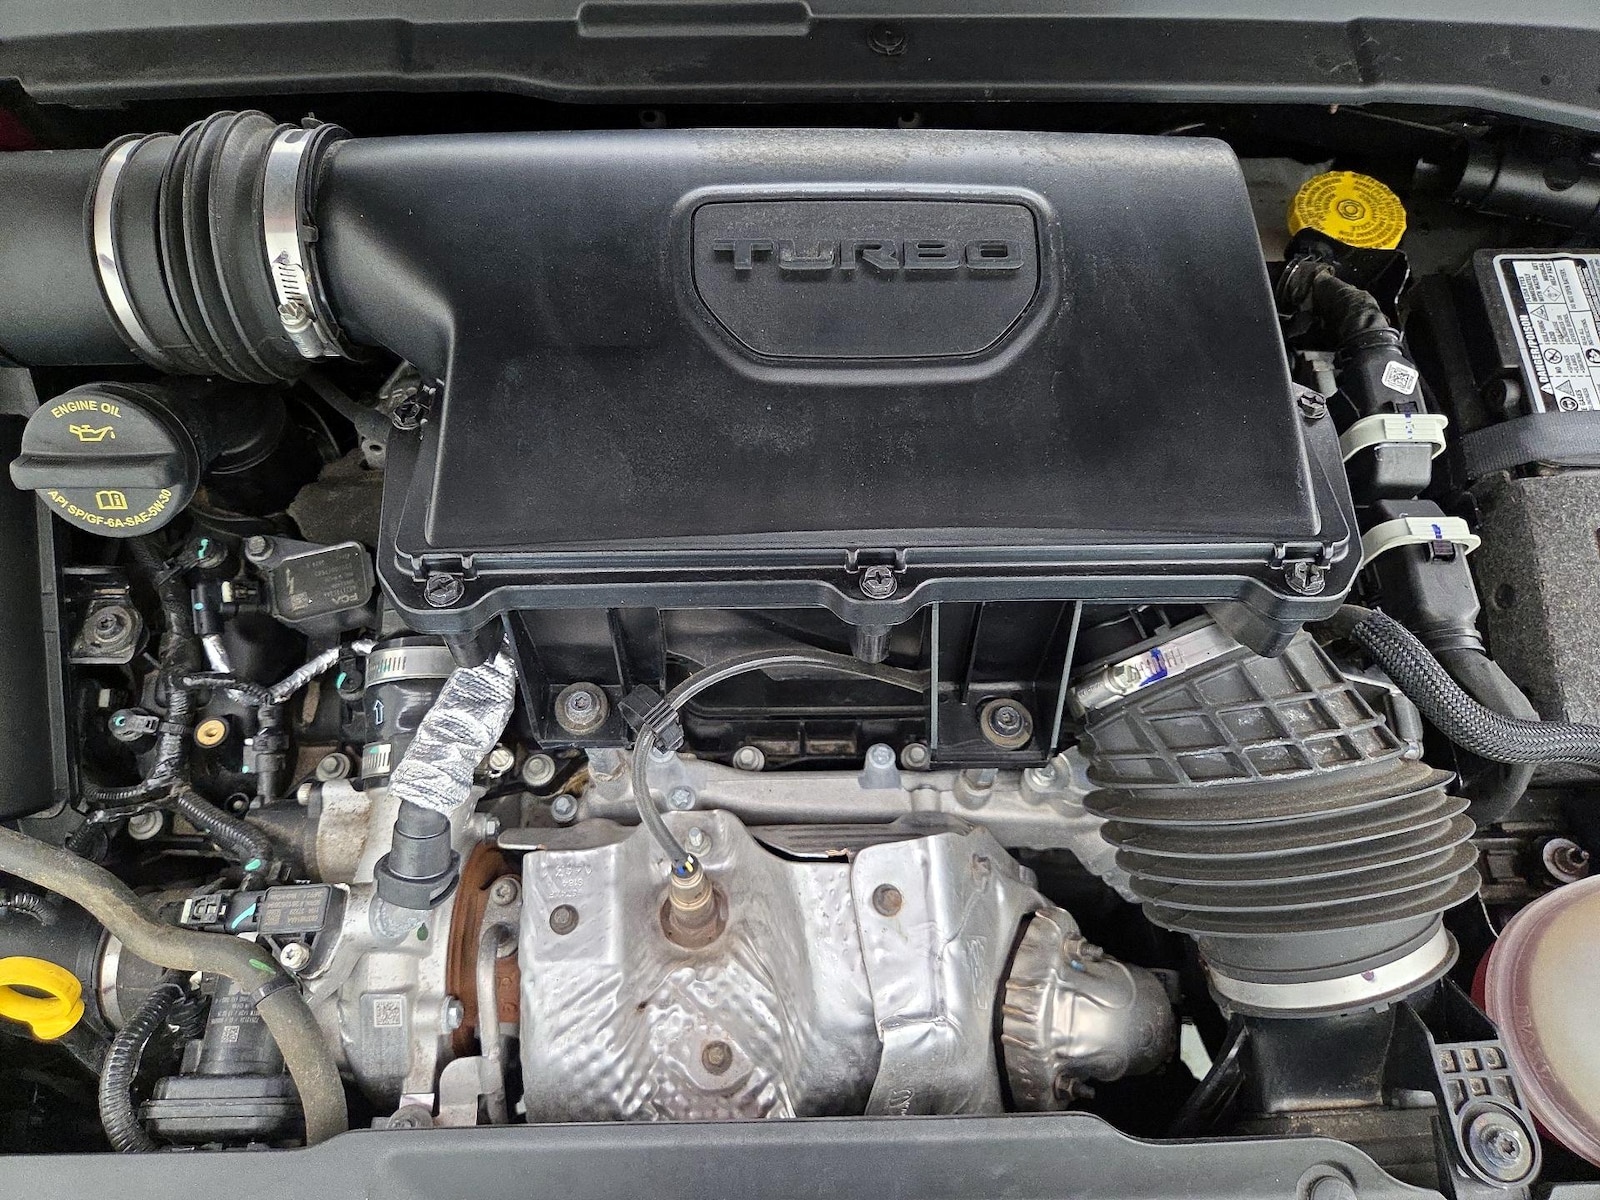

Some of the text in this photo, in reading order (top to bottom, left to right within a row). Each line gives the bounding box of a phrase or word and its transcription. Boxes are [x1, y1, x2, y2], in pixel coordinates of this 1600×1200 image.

[713, 238, 1024, 270] TURBO
[1519, 314, 1549, 383] DANGER/POISON
[51, 400, 122, 419] ENGINE OIL
[47, 488, 172, 528] API SP/GF-6A-SAE-5W-30
